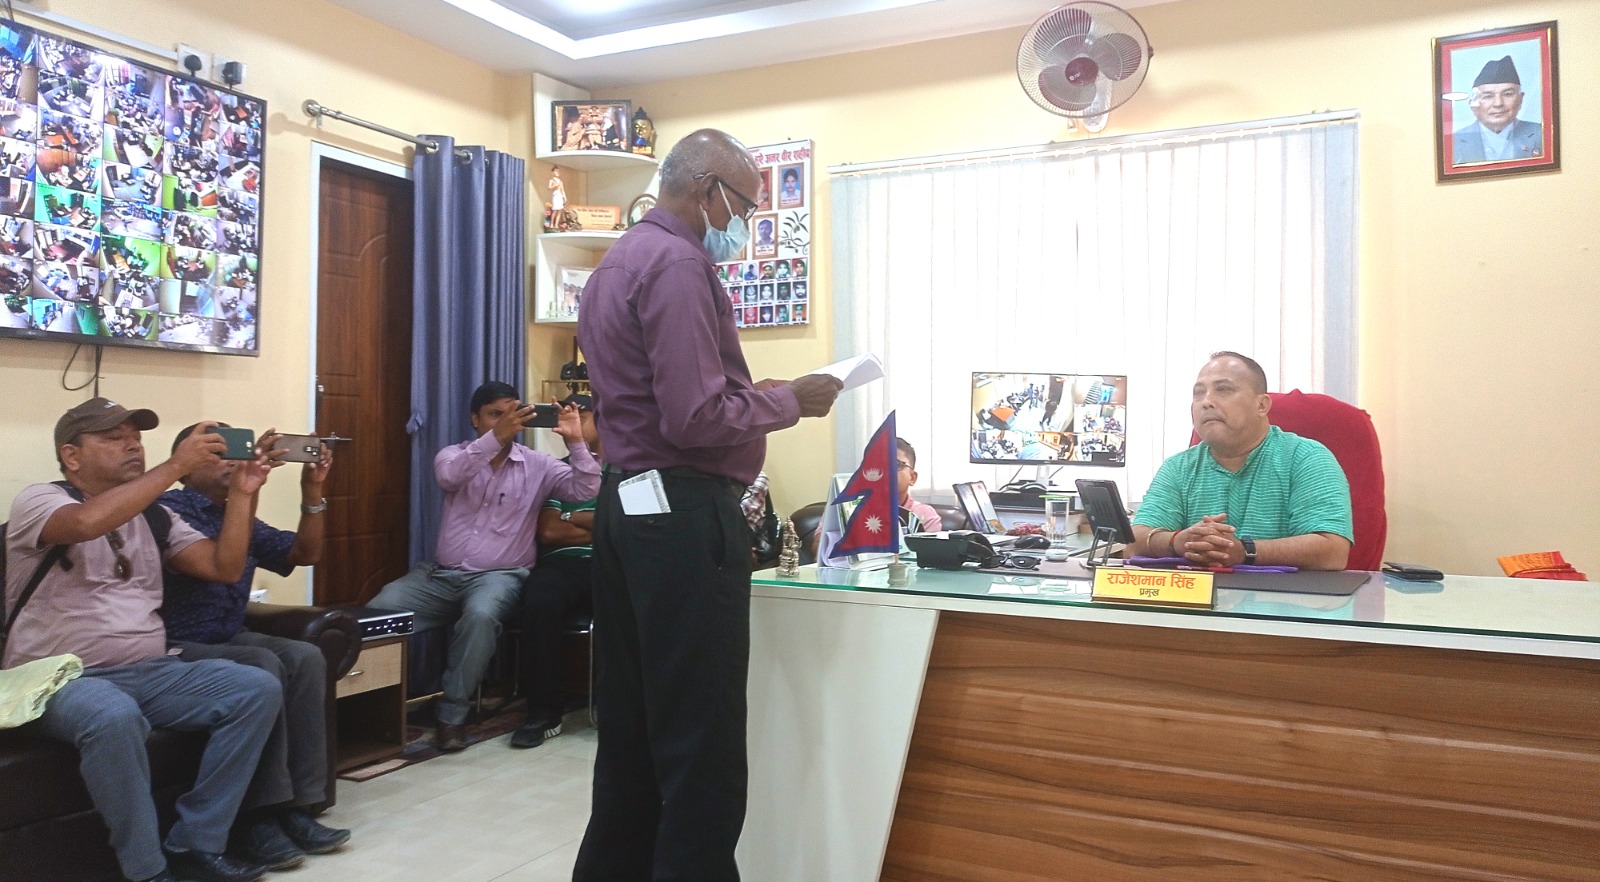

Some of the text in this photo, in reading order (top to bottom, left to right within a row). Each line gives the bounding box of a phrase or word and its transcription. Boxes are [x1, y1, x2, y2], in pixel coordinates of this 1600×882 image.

[1106, 571, 1196, 589] राजेशमान सिंह
[1139, 588, 1160, 597] प्रमुख
